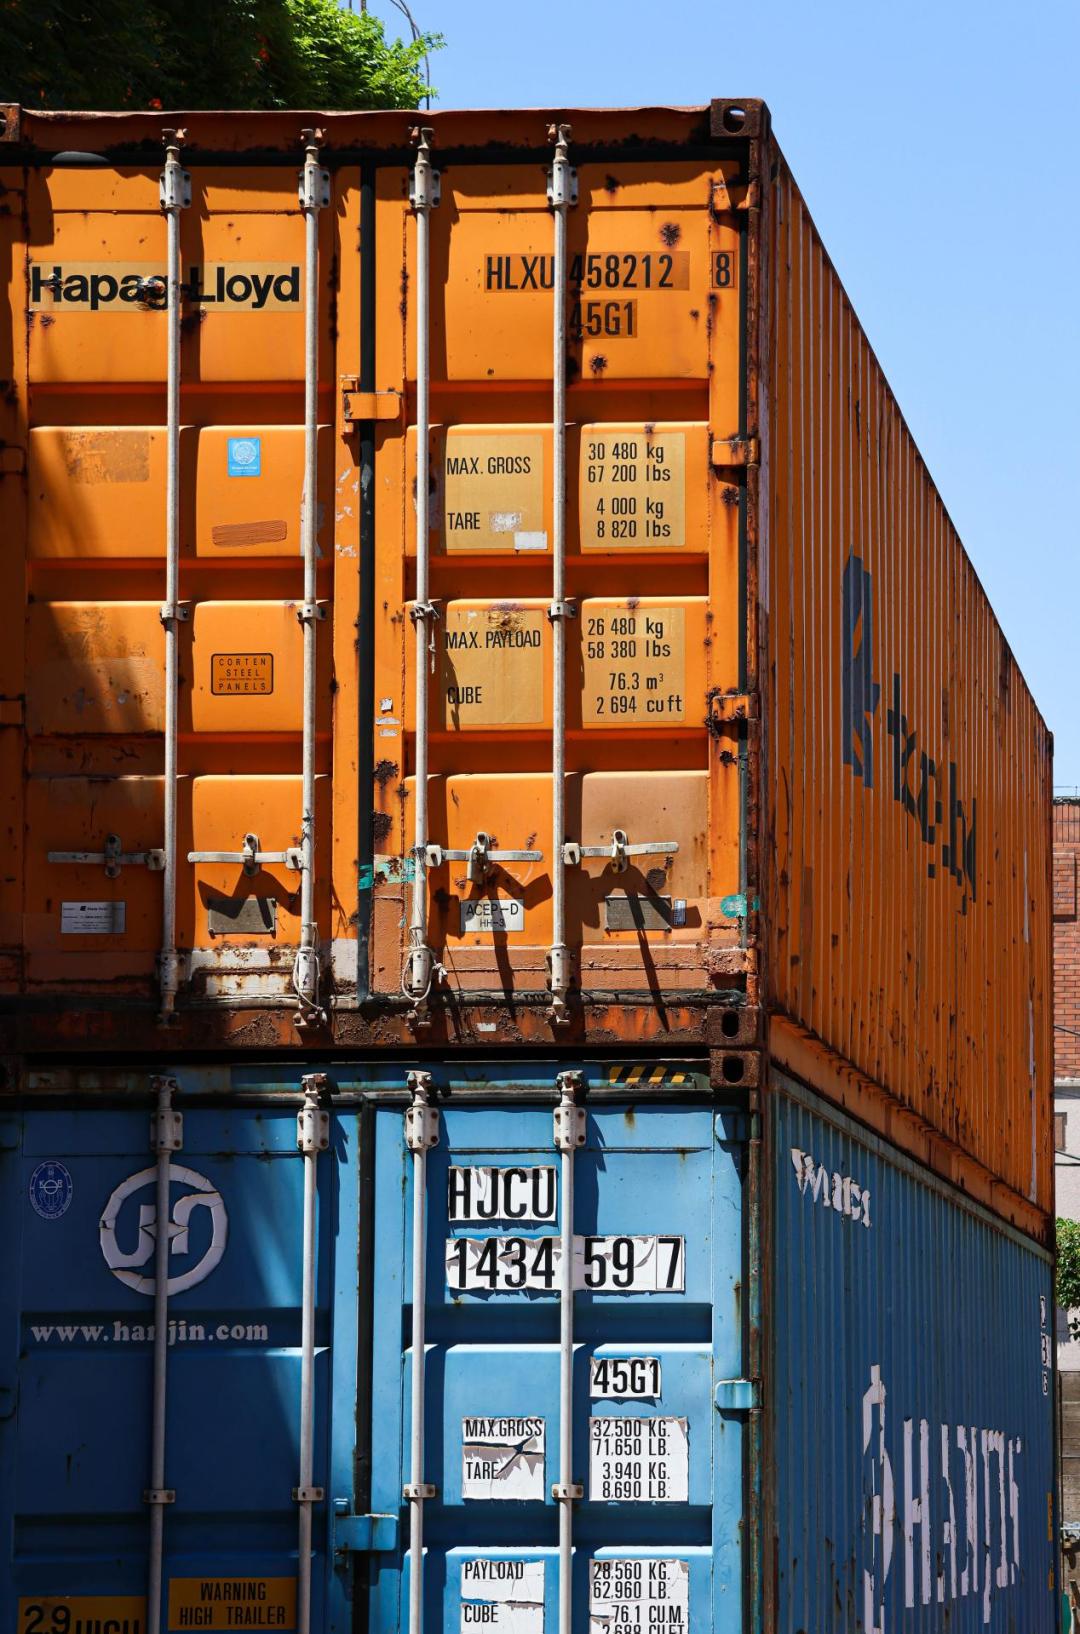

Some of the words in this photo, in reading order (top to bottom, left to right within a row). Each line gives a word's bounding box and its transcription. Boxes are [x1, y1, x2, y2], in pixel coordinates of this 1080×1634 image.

[486, 255, 556, 290] HLXU
[569, 254, 673, 289] 458212
[715, 253, 731, 287] 8
[569, 301, 635, 336] 45G1
[588, 443, 606, 460] 30
[612, 443, 638, 460] 480
[646, 442, 664, 463] kg
[447, 458, 484, 475] MAX.
[487, 457, 531, 474] GROSS
[588, 467, 604, 483] 67
[611, 466, 637, 482] 200
[646, 465, 671, 482] lbs
[596, 498, 606, 515] 4
[611, 498, 637, 514] 000
[646, 498, 664, 519] kg
[447, 513, 481, 530] TARE
[597, 521, 606, 538] 8
[611, 521, 637, 537] 820
[646, 520, 671, 537] lbs
[588, 618, 605, 635] 26
[611, 618, 636, 635] 480
[646, 617, 664, 638] kg
[445, 631, 482, 649] MAX.
[486, 630, 541, 648] PAYLOAD
[587, 641, 604, 659] 58
[611, 641, 637, 658] 380
[646, 640, 671, 657] lbs
[218, 658, 266, 666] CORTEN
[226, 668, 260, 677] STEEL
[609, 672, 640, 691] 76.3
[218, 682, 266, 691] PANELS
[447, 686, 482, 705] CUBE
[596, 697, 605, 714] 2
[611, 696, 637, 714] 694
[450, 1168, 555, 1219] HJCU
[453, 1237, 555, 1289] 1434
[584, 1237, 634, 1288] 59
[657, 1237, 681, 1289] 7
[593, 1359, 659, 1394] 45G1
[593, 1419, 642, 1438] 32,500
[648, 1419, 671, 1437] KG.
[594, 1438, 642, 1457] 71,650
[648, 1438, 671, 1456] LB.
[465, 1461, 499, 1480] TARE
[602, 1462, 642, 1481] 3,940
[648, 1462, 671, 1480] KG.
[602, 1481, 642, 1500] 8,690
[648, 1481, 671, 1499] LB.
[464, 1562, 524, 1580] PAYLOAD
[593, 1562, 642, 1581] 28,560
[648, 1562, 671, 1580] KG.
[200, 1582, 266, 1601] WARNING
[593, 1581, 642, 1600] 62,960
[648, 1581, 671, 1599] LB.
[179, 1606, 213, 1625] HIGH
[226, 1606, 286, 1625] TRAILER
[464, 1605, 499, 1623] CUBE
[611, 1605, 641, 1623] 76.1
[648, 1605, 685, 1623] CU.M.
[602, 1624, 642, 1634] 2688
